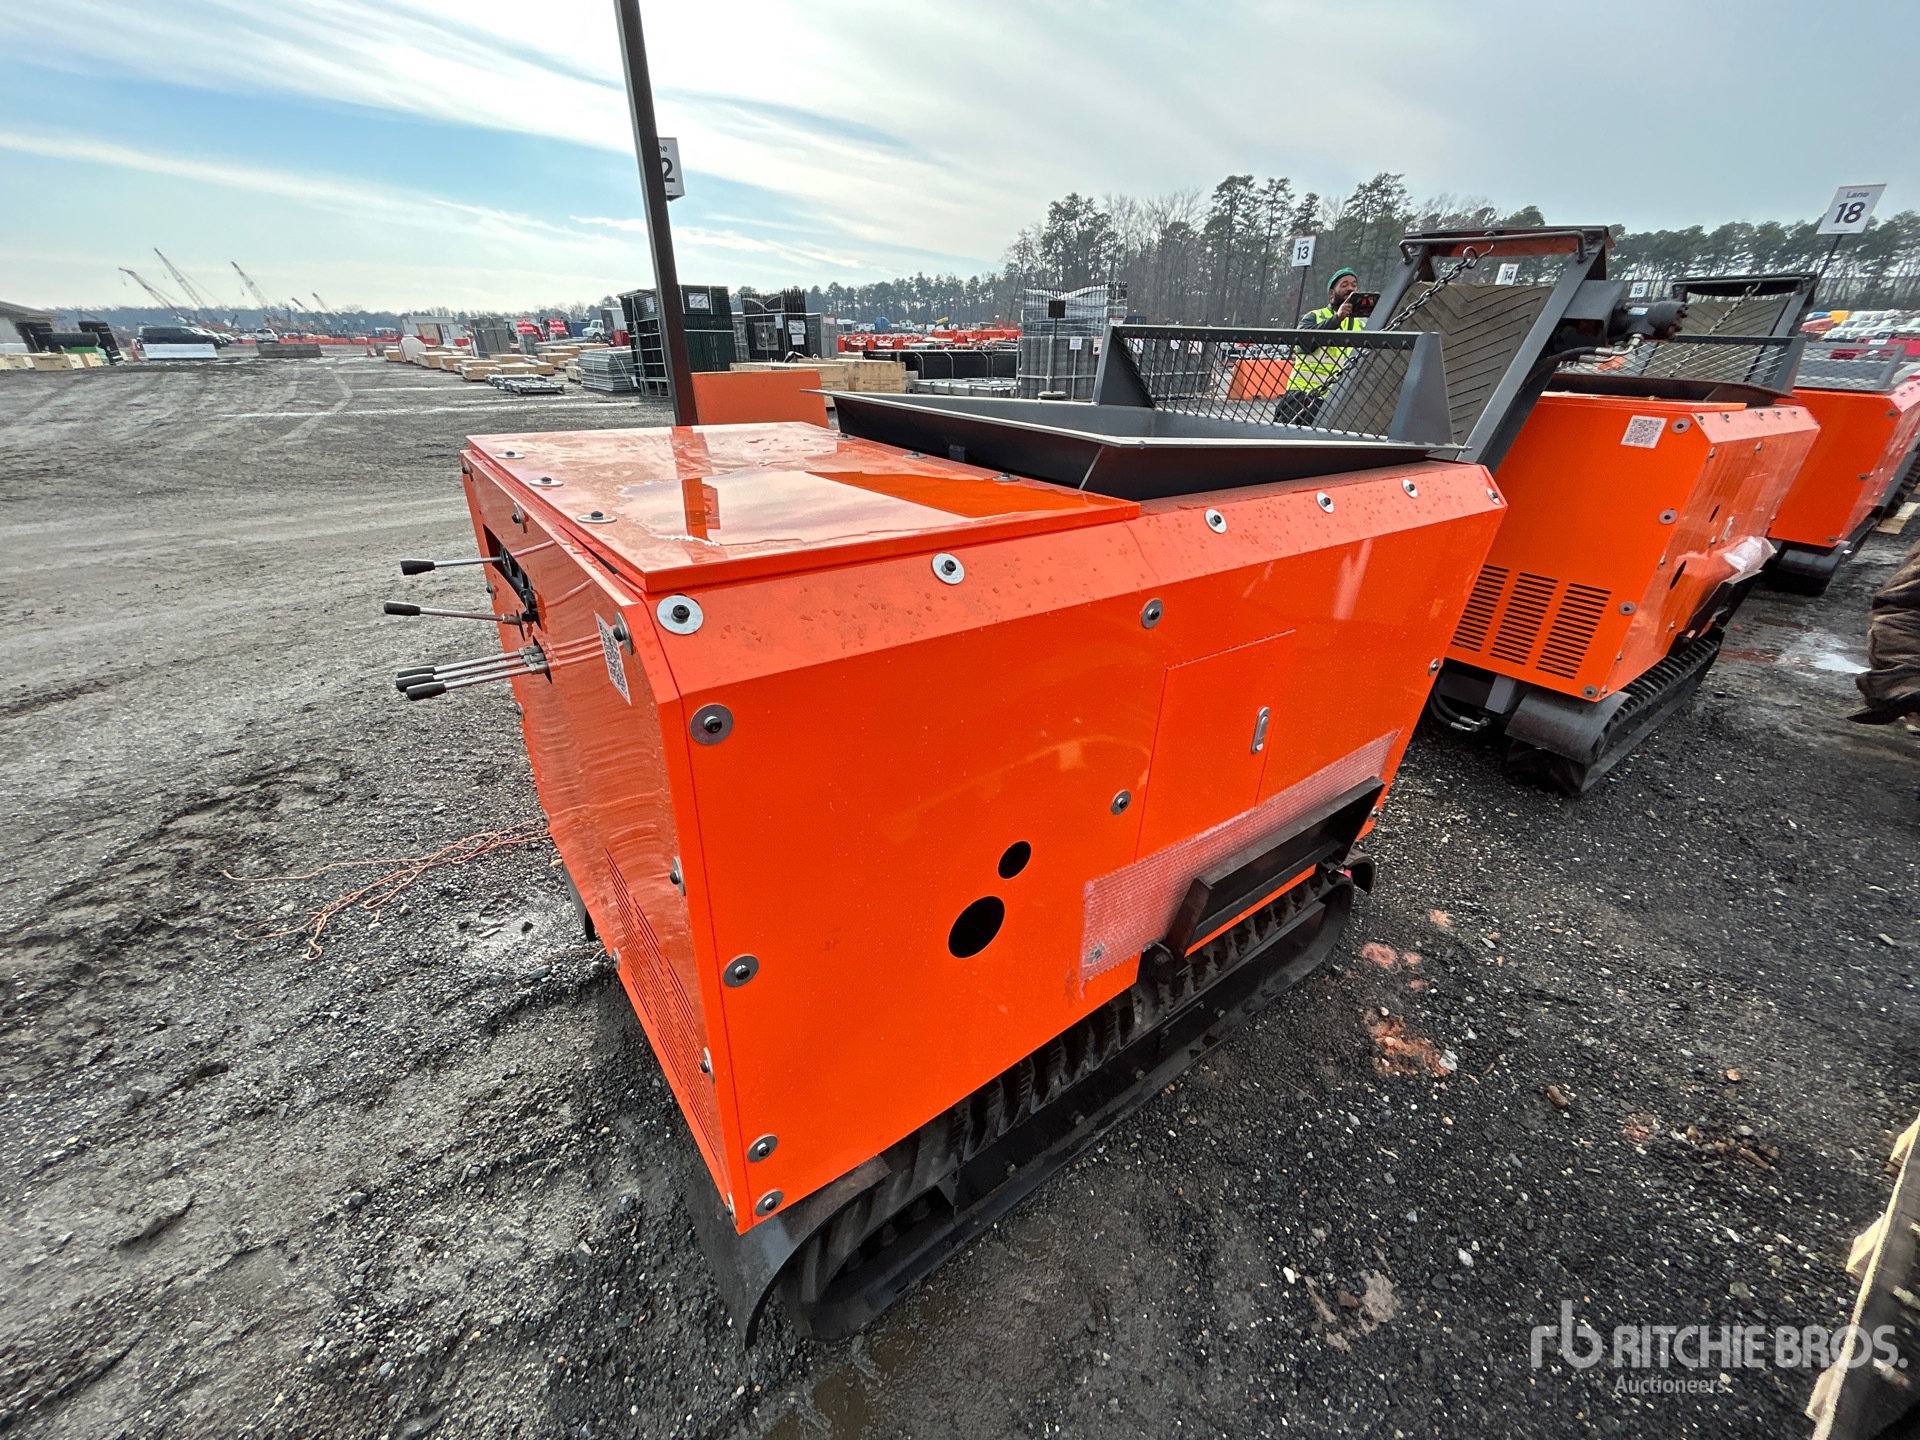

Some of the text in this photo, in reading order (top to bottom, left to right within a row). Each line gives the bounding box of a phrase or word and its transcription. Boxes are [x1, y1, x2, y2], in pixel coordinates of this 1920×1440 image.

[661, 157, 676, 183] 2
[1845, 191, 1870, 199] Lane
[1833, 201, 1866, 224] 18
[1297, 245, 1310, 260] 13
[1504, 270, 1514, 281] 14
[1633, 286, 1644, 295] 15
